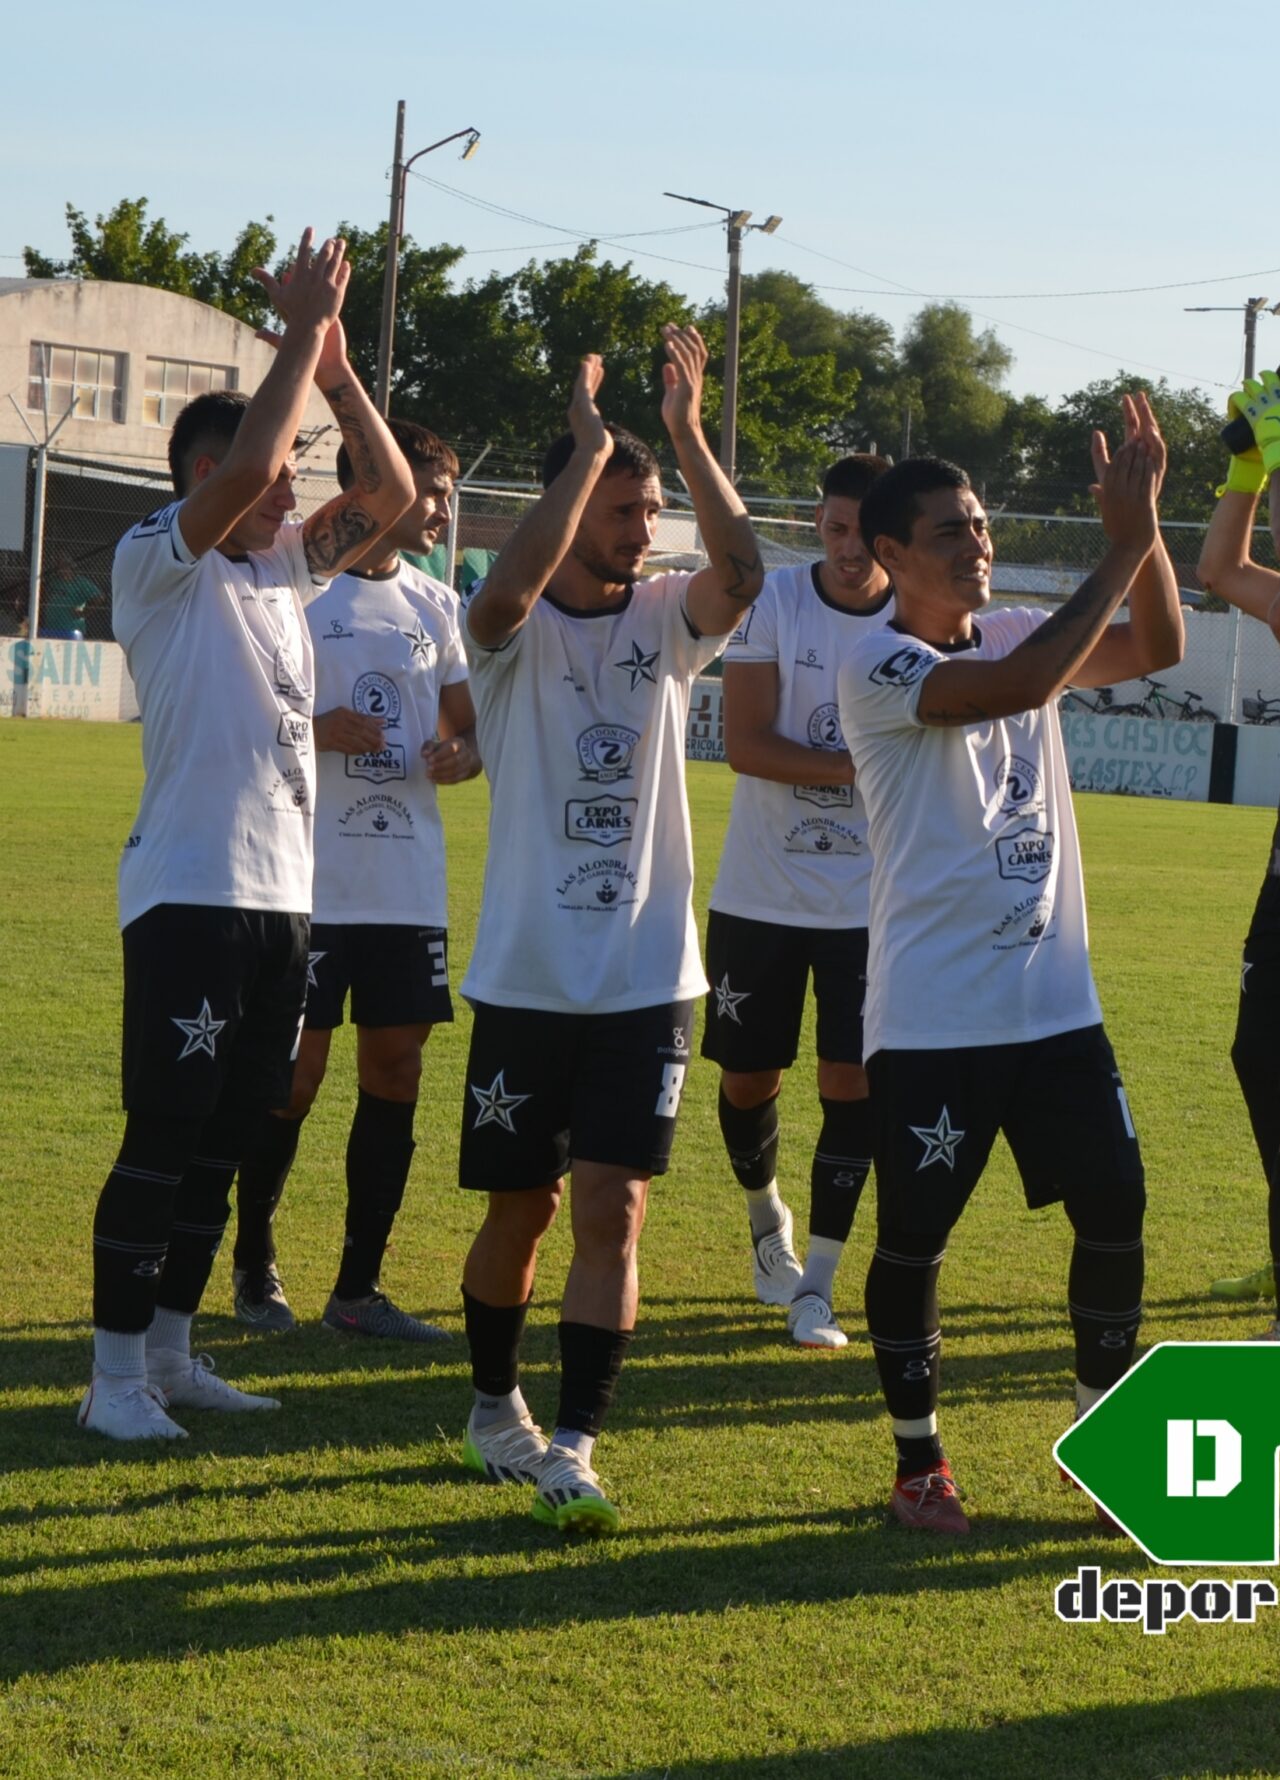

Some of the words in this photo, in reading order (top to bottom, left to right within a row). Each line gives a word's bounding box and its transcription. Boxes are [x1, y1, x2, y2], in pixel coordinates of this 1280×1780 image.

[6, 640, 103, 687] SAIN
[1061, 713, 1097, 748] RES
[354, 758, 401, 770] CARNES
[1072, 755, 1167, 788] CASTEX
[575, 816, 632, 829] CARNES
[584, 805, 622, 817] EXPO
[1013, 839, 1046, 854] EXPO
[555, 872, 577, 896] LAS
[577, 859, 628, 877] ALONDRA
[654, 1062, 686, 1118] 8
